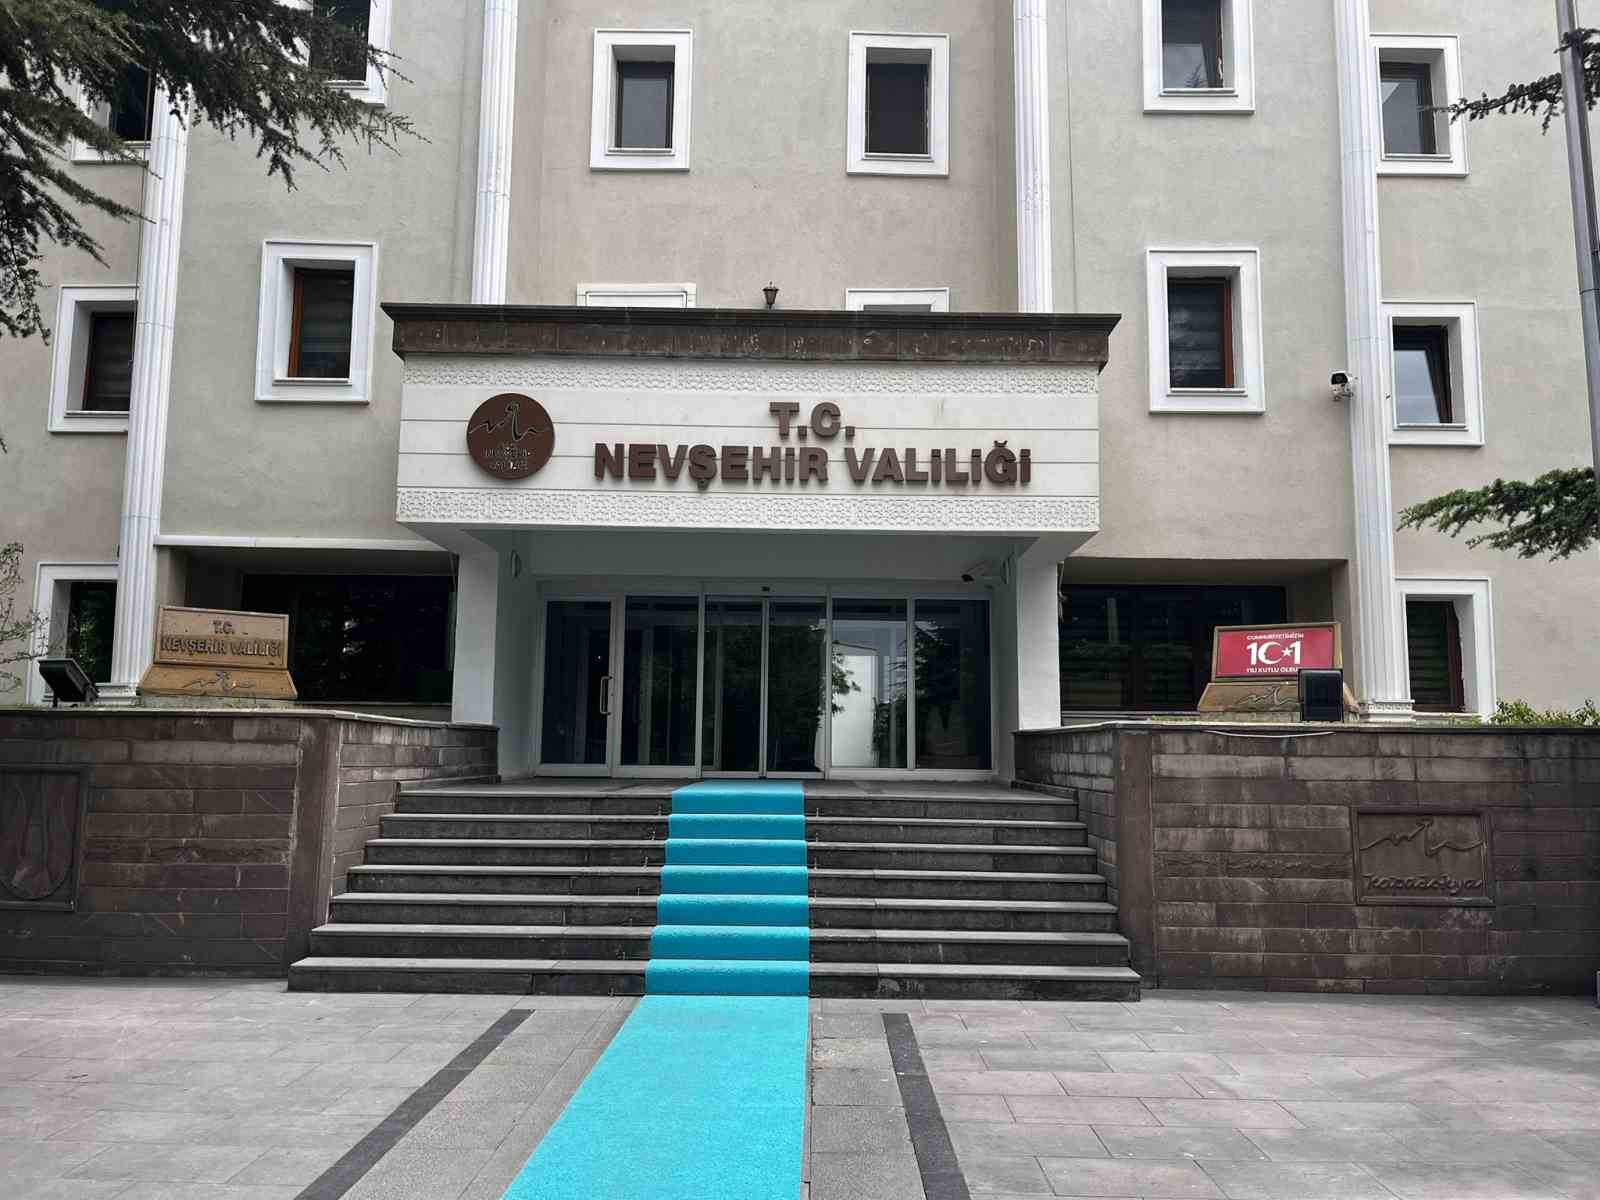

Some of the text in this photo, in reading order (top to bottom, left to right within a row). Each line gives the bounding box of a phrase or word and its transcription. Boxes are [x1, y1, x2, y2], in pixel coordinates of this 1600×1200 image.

[770, 401, 855, 439] T.C.
[594, 440, 1032, 489] NEVŞEHİR VALİLİĞİ
